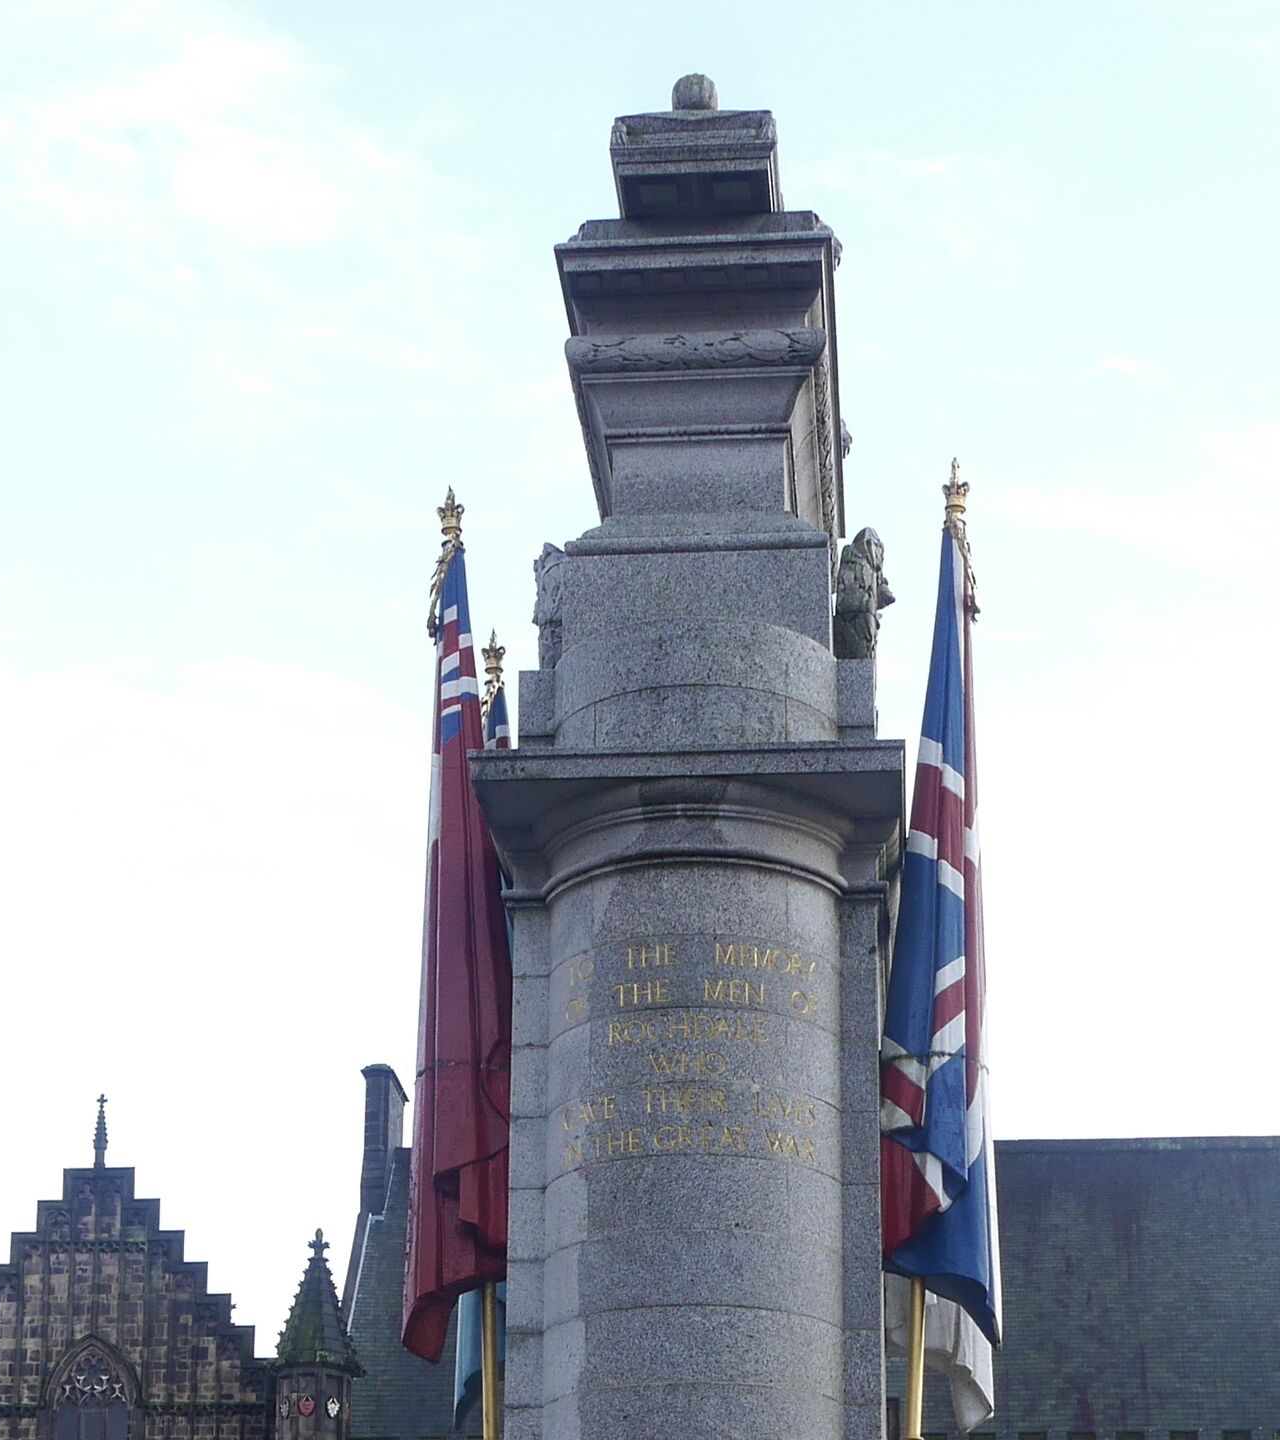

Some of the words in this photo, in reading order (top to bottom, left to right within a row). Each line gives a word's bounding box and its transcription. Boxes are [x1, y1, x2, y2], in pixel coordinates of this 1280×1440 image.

[568, 957, 595, 986] TO
[625, 944, 678, 970] THE
[613, 979, 671, 1007] THE
[703, 978, 765, 1006] MEN
[791, 991, 819, 1014] OF
[607, 1014, 770, 1047] ROCHDALE
[648, 1051, 729, 1076] WHO
[640, 1087, 733, 1114] THEIR
[755, 1091, 817, 1129] LIVES
[592, 1127, 645, 1158] THE
[652, 1124, 750, 1151] GREAT
[764, 1129, 817, 1162] WAR
